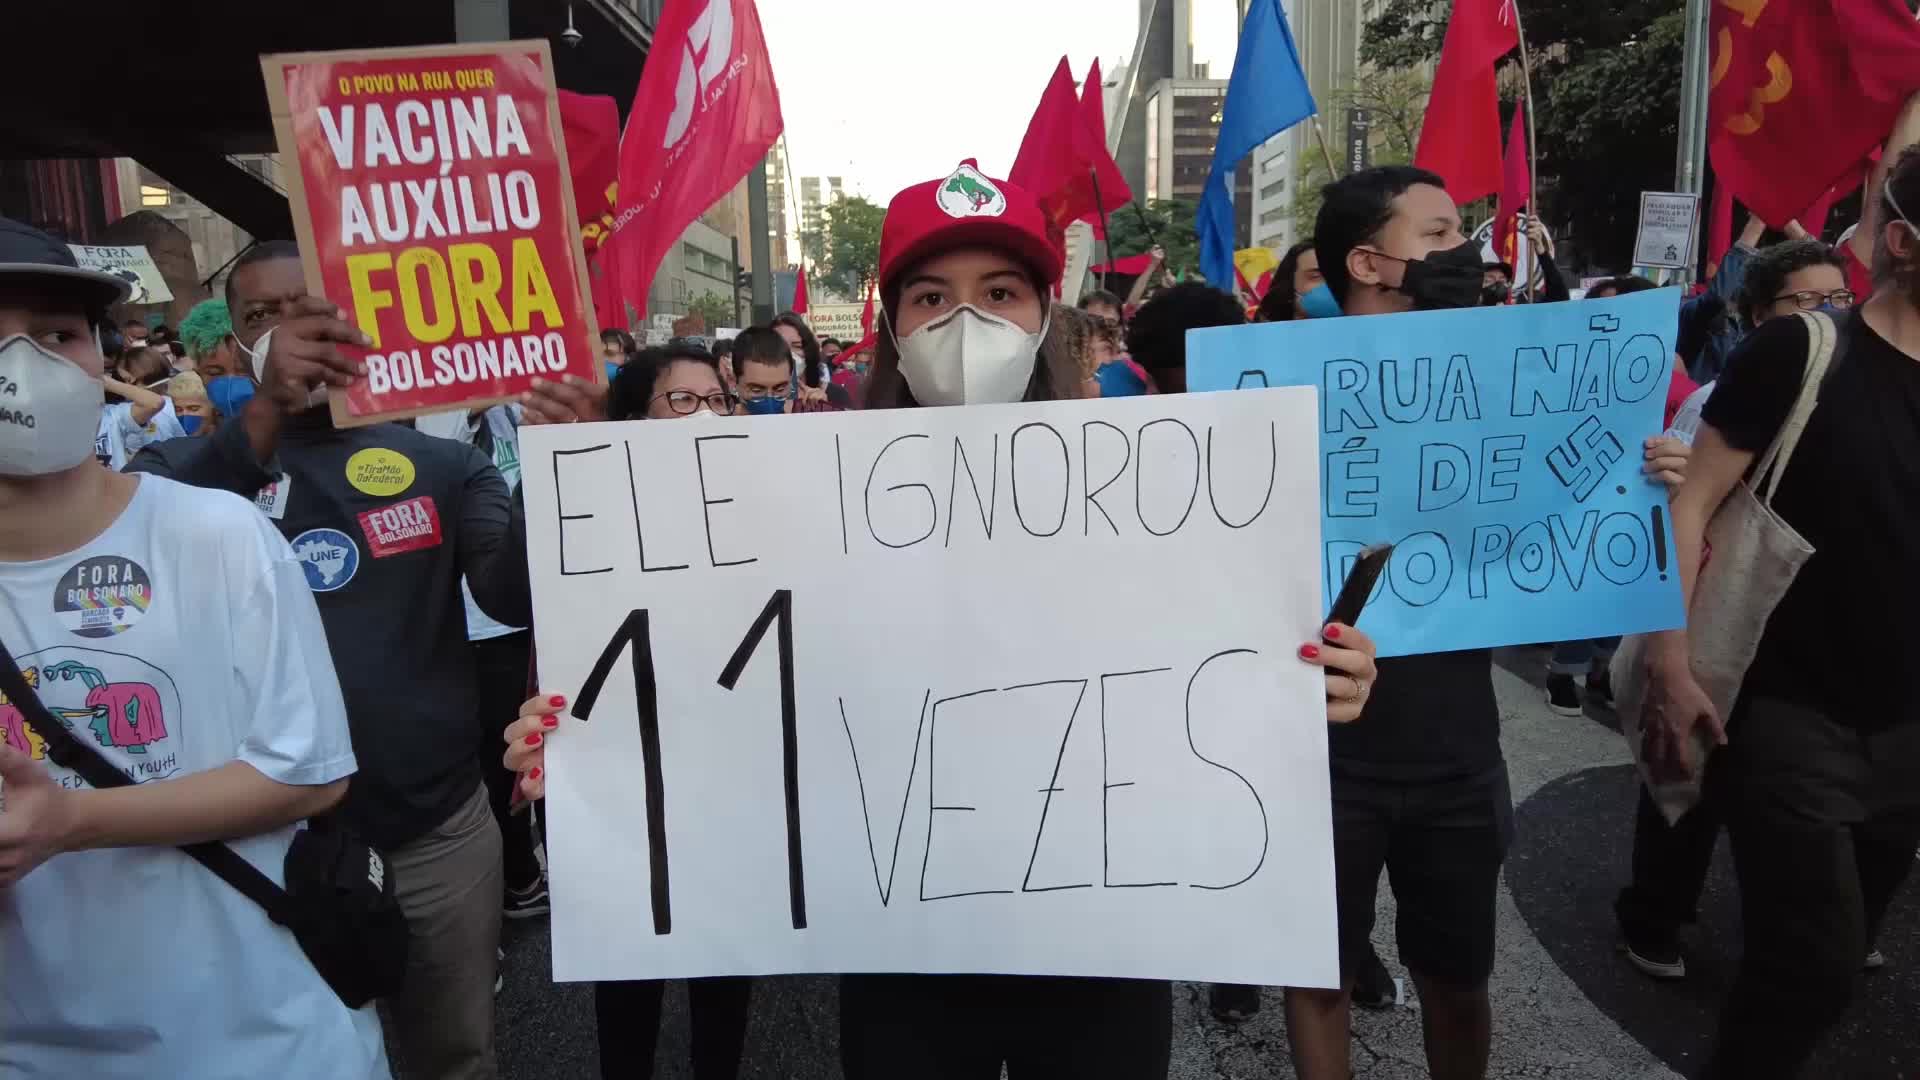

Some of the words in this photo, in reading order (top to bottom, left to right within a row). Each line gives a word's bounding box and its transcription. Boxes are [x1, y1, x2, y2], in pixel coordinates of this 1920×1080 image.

[339, 77, 351, 95] O
[353, 74, 394, 95] POVO
[398, 72, 420, 92] NA
[422, 70, 453, 91] RUA
[455, 68, 496, 90] QUER
[317, 94, 532, 170] VACINA
[341, 160, 542, 247] AUXÍLIO
[84, 246, 133, 258] FORA
[346, 237, 565, 349] FORA
[365, 332, 569, 395] BOLSONARO
[1323, 353, 1482, 434] RUA
[1509, 313, 1667, 418] NÃO
[552, 433, 759, 576] ELE
[835, 417, 1277, 555] IGNOROU
[1325, 435, 1380, 519] É
[1416, 433, 1527, 513] DE
[367, 501, 432, 536] FORA
[377, 522, 434, 545] BOLSONARO
[1467, 503, 1668, 601] POVO!
[77, 563, 134, 586] FORA
[309, 548, 342, 562] UNE
[67, 583, 145, 603] BOLSONARO
[570, 587, 809, 936] 11
[838, 647, 1270, 908] VEZES
